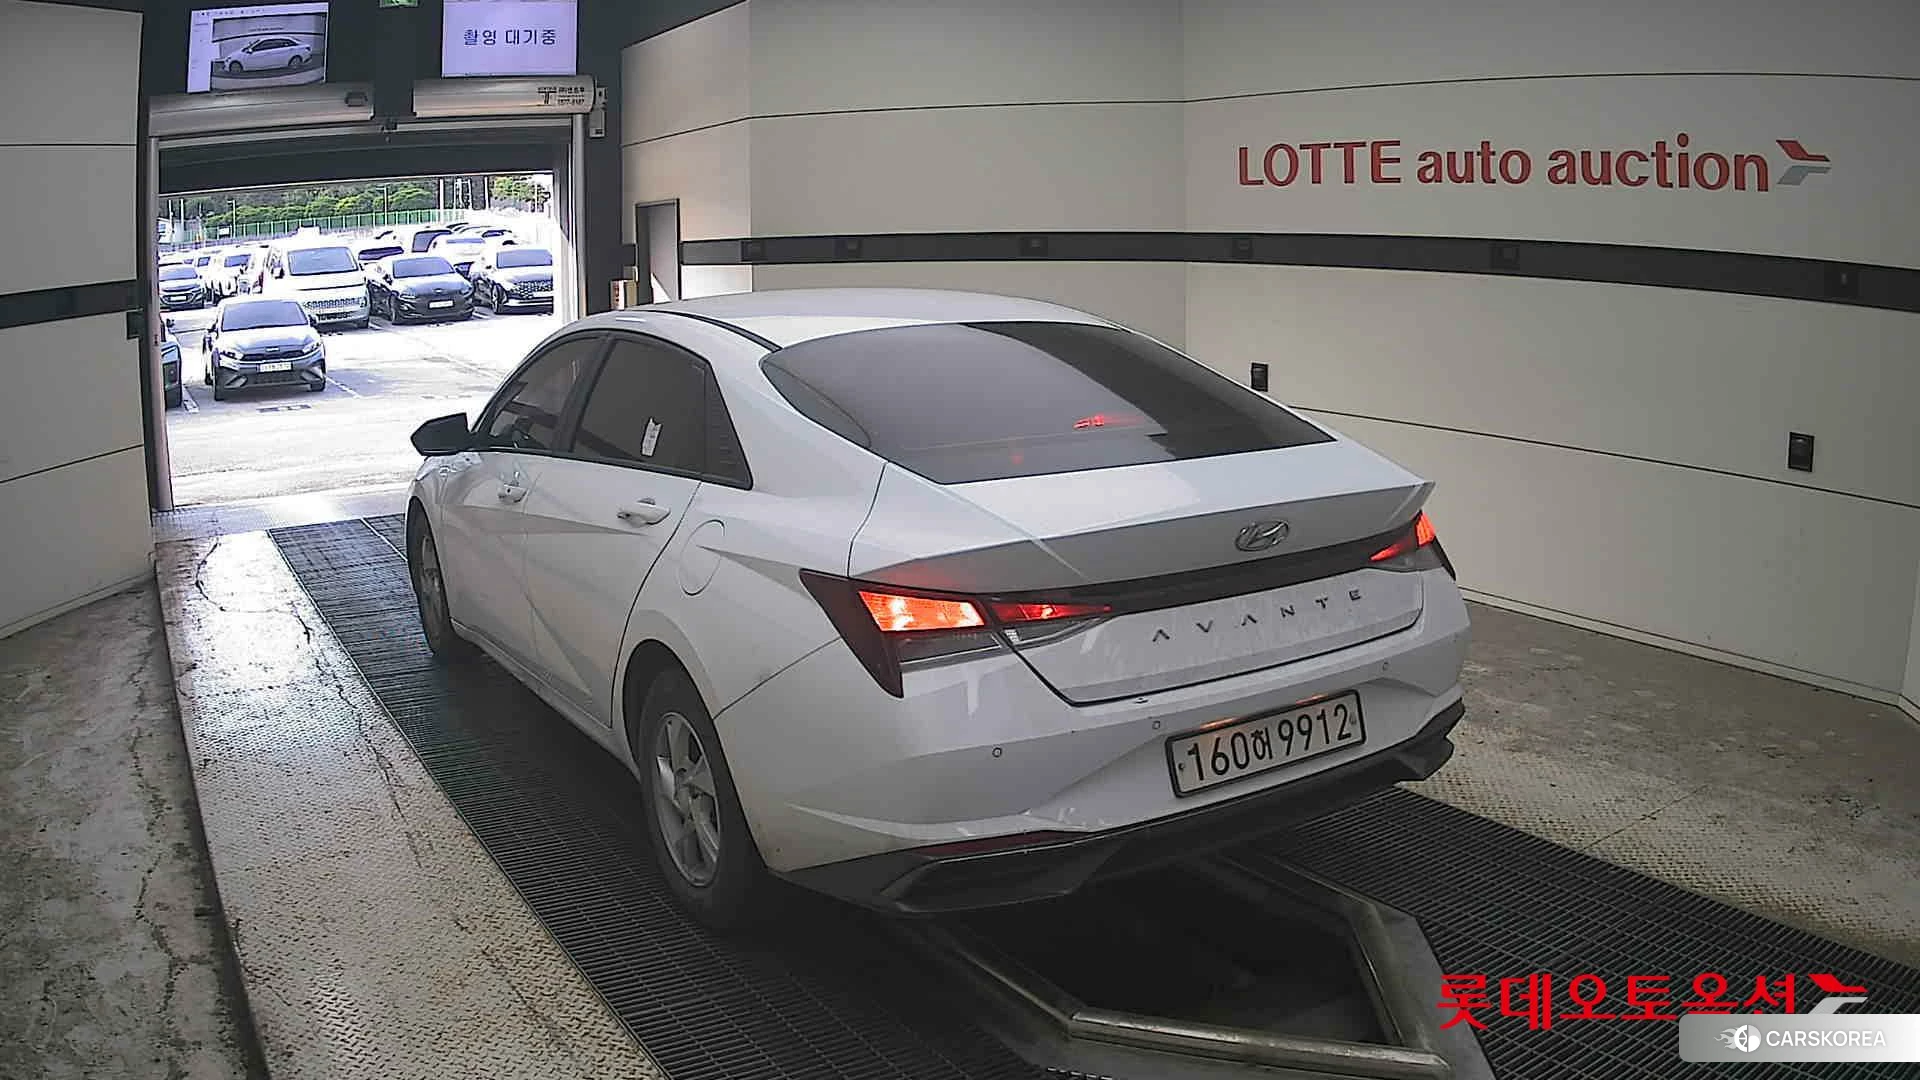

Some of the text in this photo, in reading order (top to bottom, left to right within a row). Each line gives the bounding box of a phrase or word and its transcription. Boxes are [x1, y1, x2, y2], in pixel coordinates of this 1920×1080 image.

[463, 28, 557, 46] 촬영 대기중
[1238, 133, 1769, 192] LOTTE auto auction
[1152, 588, 1362, 642] AVANTE
